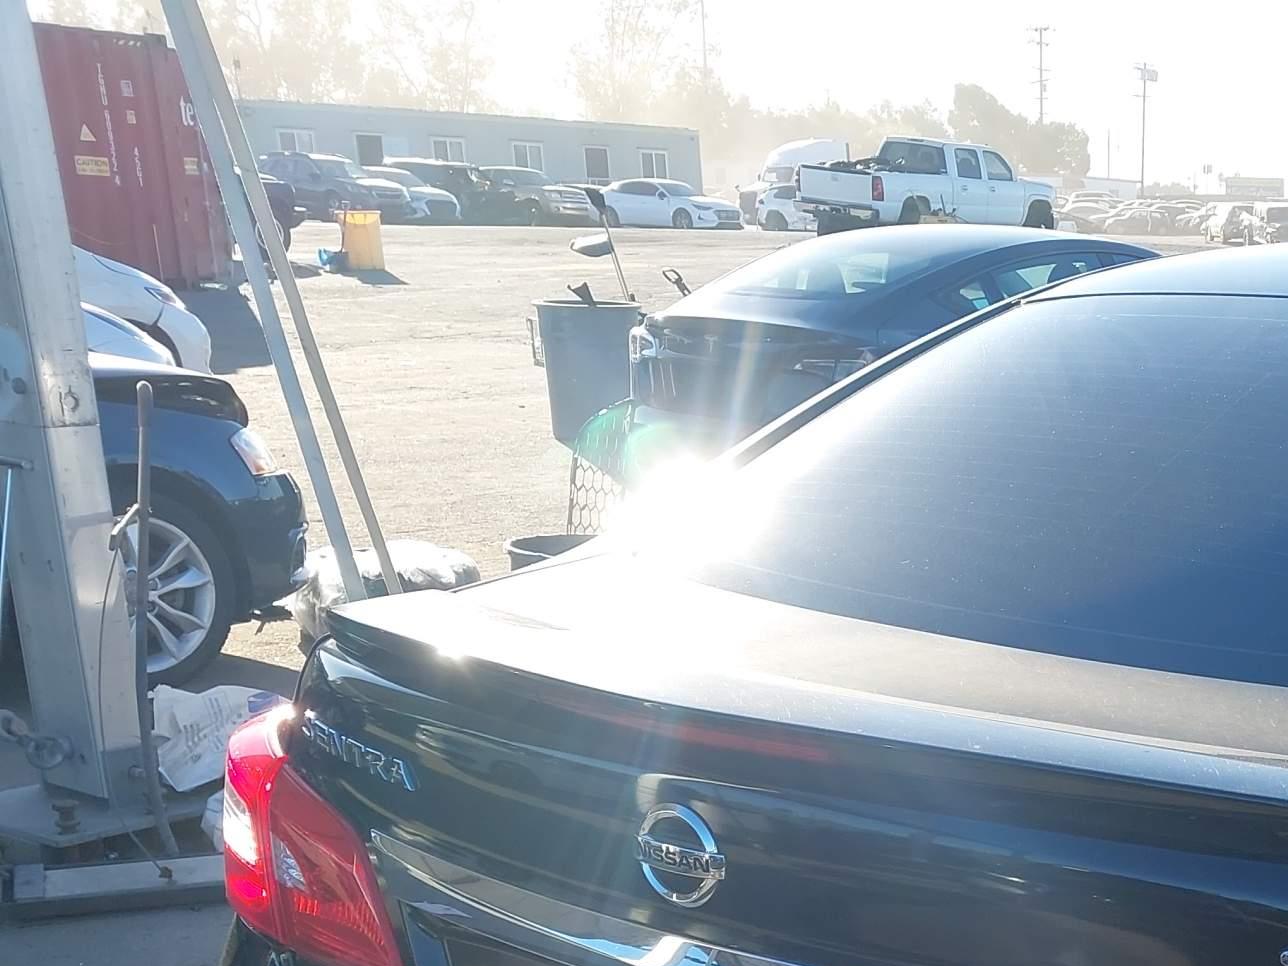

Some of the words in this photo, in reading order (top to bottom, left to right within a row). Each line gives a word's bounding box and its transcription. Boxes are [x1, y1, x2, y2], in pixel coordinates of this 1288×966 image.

[180, 95, 195, 126] te
[76, 158, 108, 167] CAUTION
[302, 709, 415, 791] SENTRA
[640, 838, 711, 874] NISSAN
